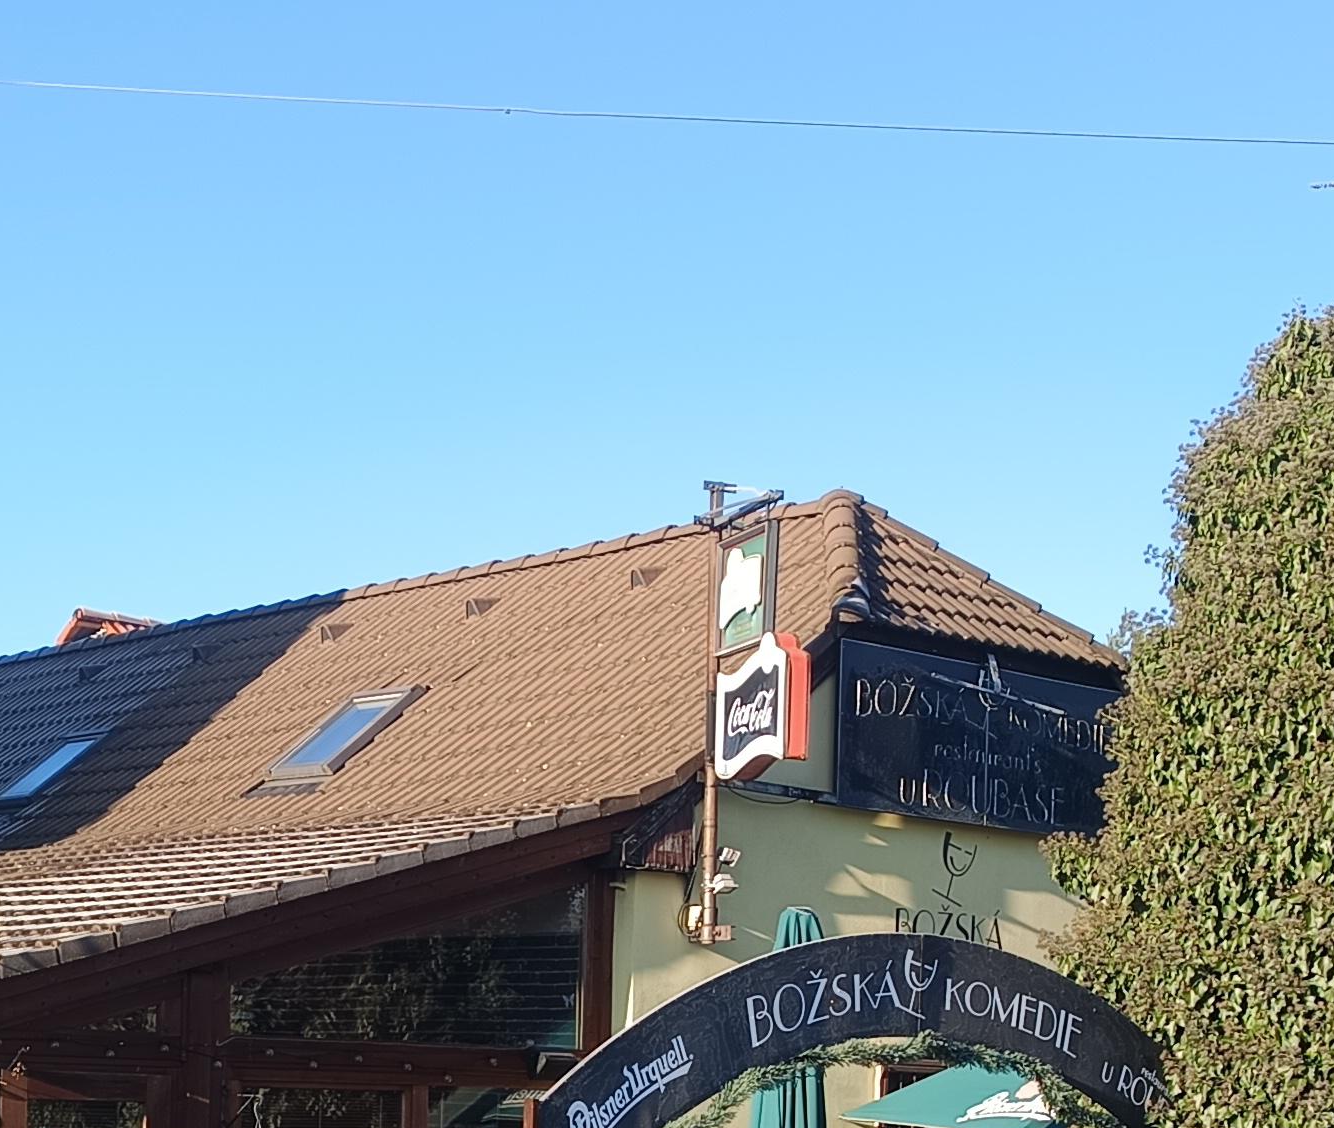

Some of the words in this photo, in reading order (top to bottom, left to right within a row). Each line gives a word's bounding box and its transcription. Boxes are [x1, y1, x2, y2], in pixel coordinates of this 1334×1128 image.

[855, 676, 969, 721] BOŽSKÁ
[921, 768, 1066, 827] ROUBASE
[895, 904, 1003, 950] BOŽSKÁ
[746, 959, 903, 1049] BOŽSKÁ
[944, 977, 1083, 1059] KOMEDIE
